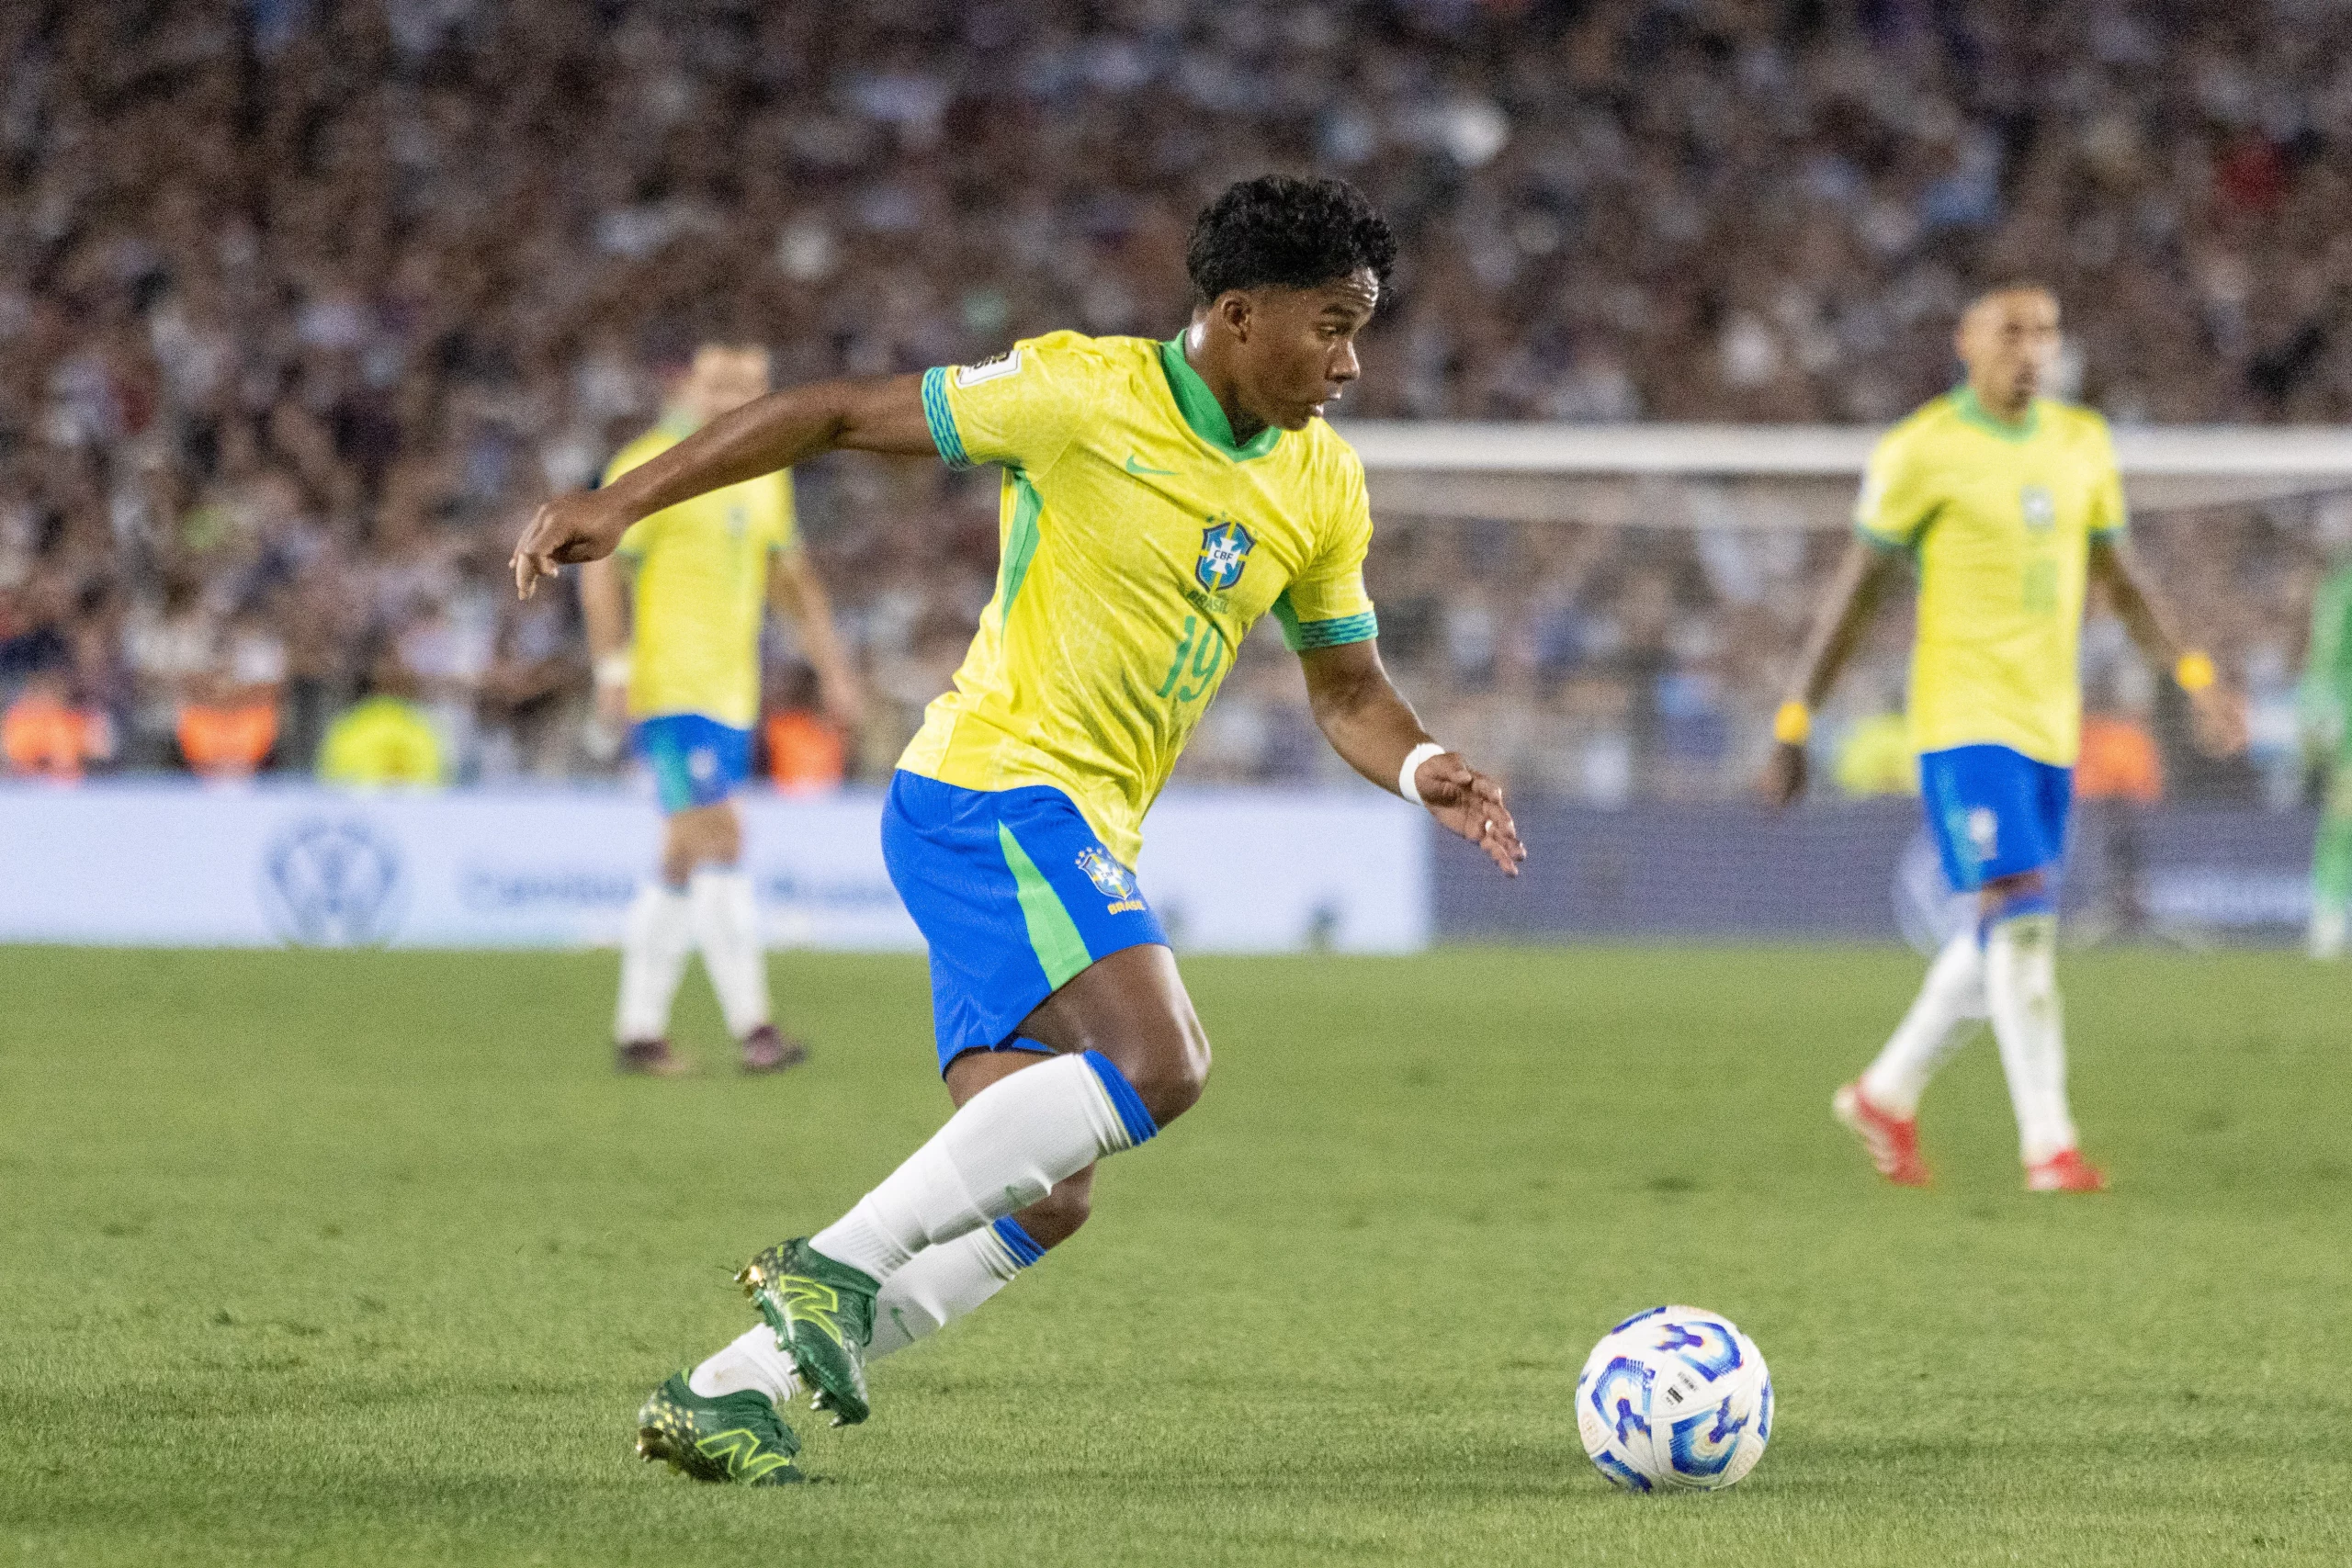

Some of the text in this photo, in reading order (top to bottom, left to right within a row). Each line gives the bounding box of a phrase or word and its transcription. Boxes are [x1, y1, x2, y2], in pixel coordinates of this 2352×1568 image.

[1214, 549, 1234, 561] CBF
[1156, 615, 1224, 703] 19
[1107, 900, 1146, 916] BRASIL
